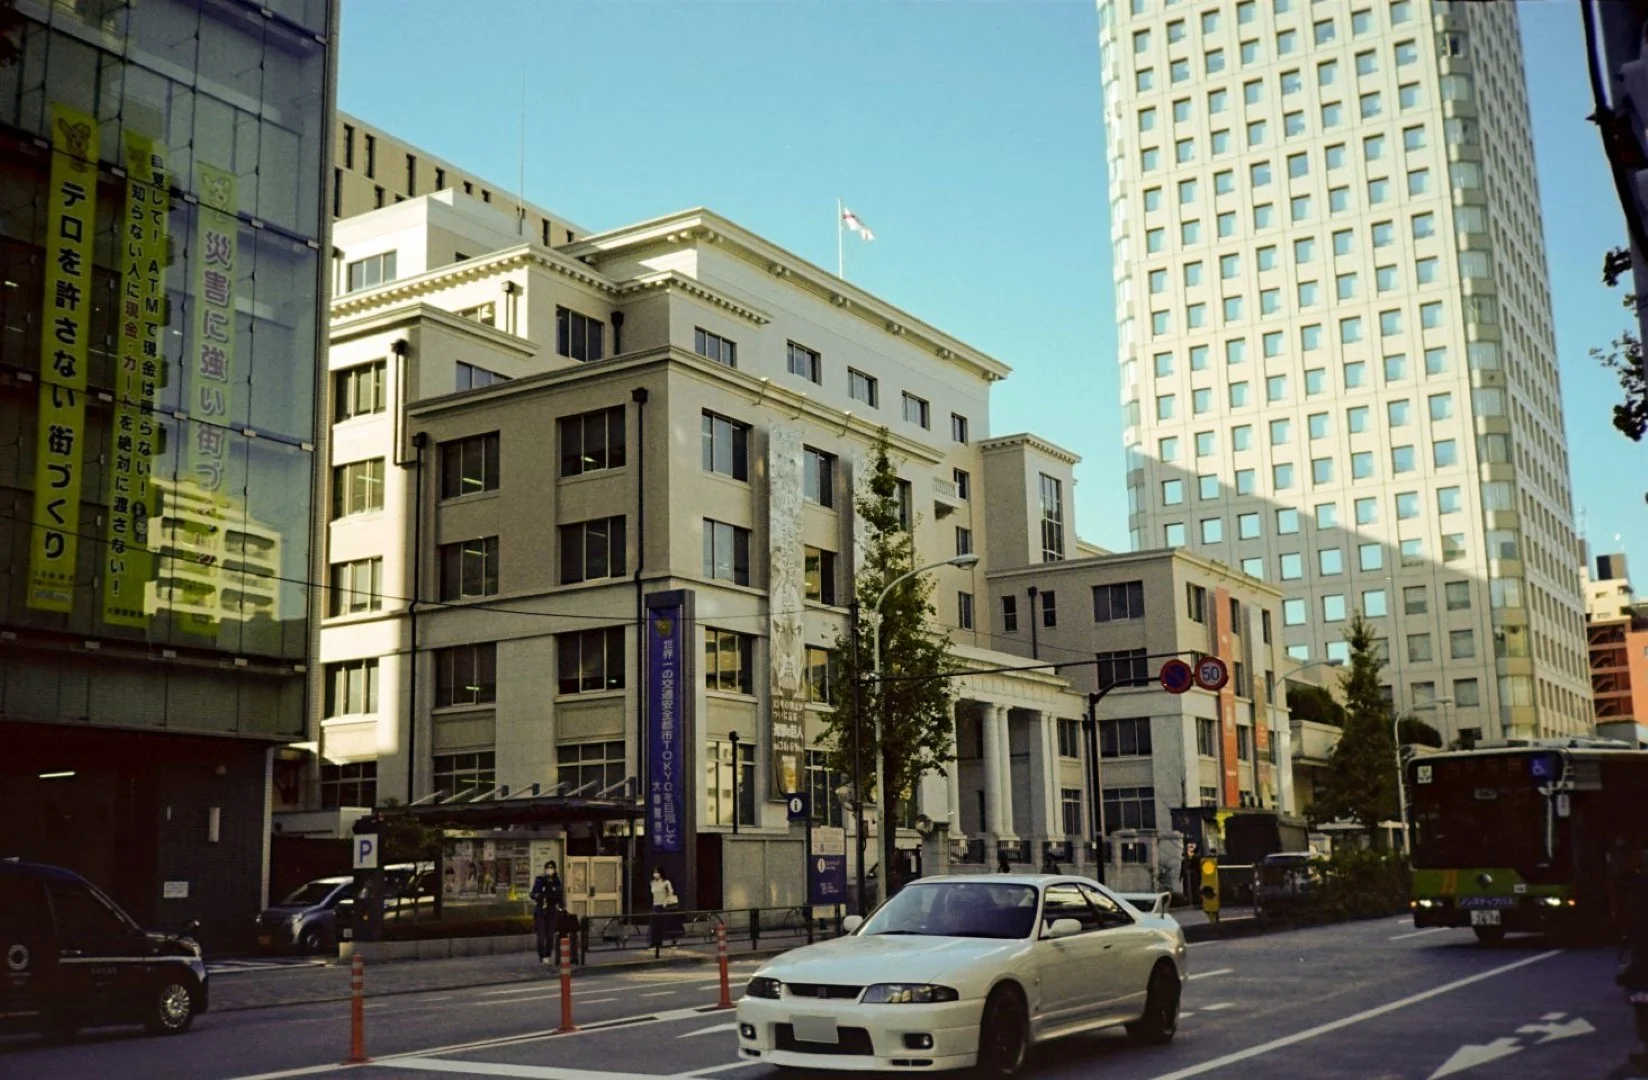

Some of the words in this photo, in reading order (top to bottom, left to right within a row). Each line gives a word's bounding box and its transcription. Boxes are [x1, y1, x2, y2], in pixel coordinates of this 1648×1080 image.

[45, 181, 86, 559] テロを許さない街づくり
[196, 231, 233, 528] 災害に強い街づ
[1201, 666, 1220, 681] 50
[360, 840, 372, 863] P
